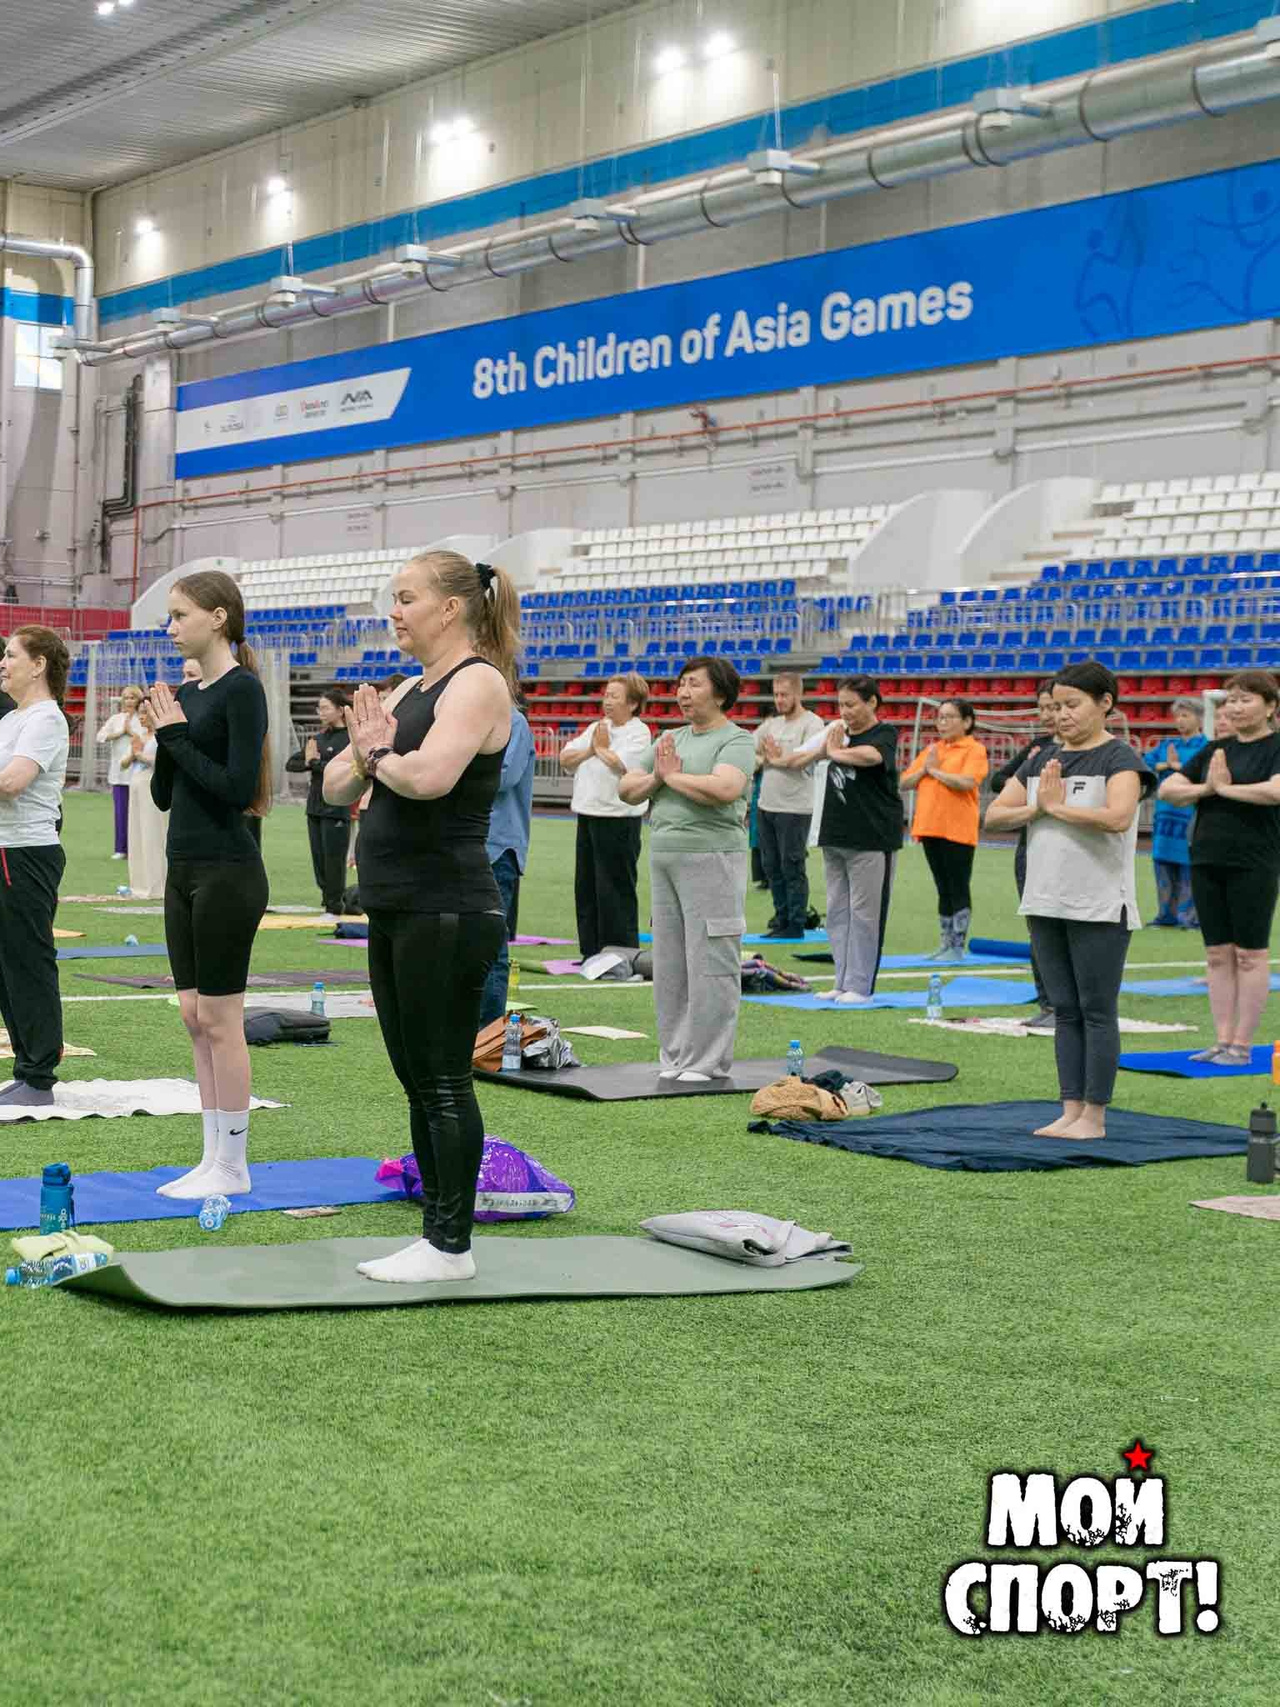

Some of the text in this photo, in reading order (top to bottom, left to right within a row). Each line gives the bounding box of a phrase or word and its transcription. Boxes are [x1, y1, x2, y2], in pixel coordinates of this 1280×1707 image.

[472, 280, 974, 399] 8th Children of Asia Games
